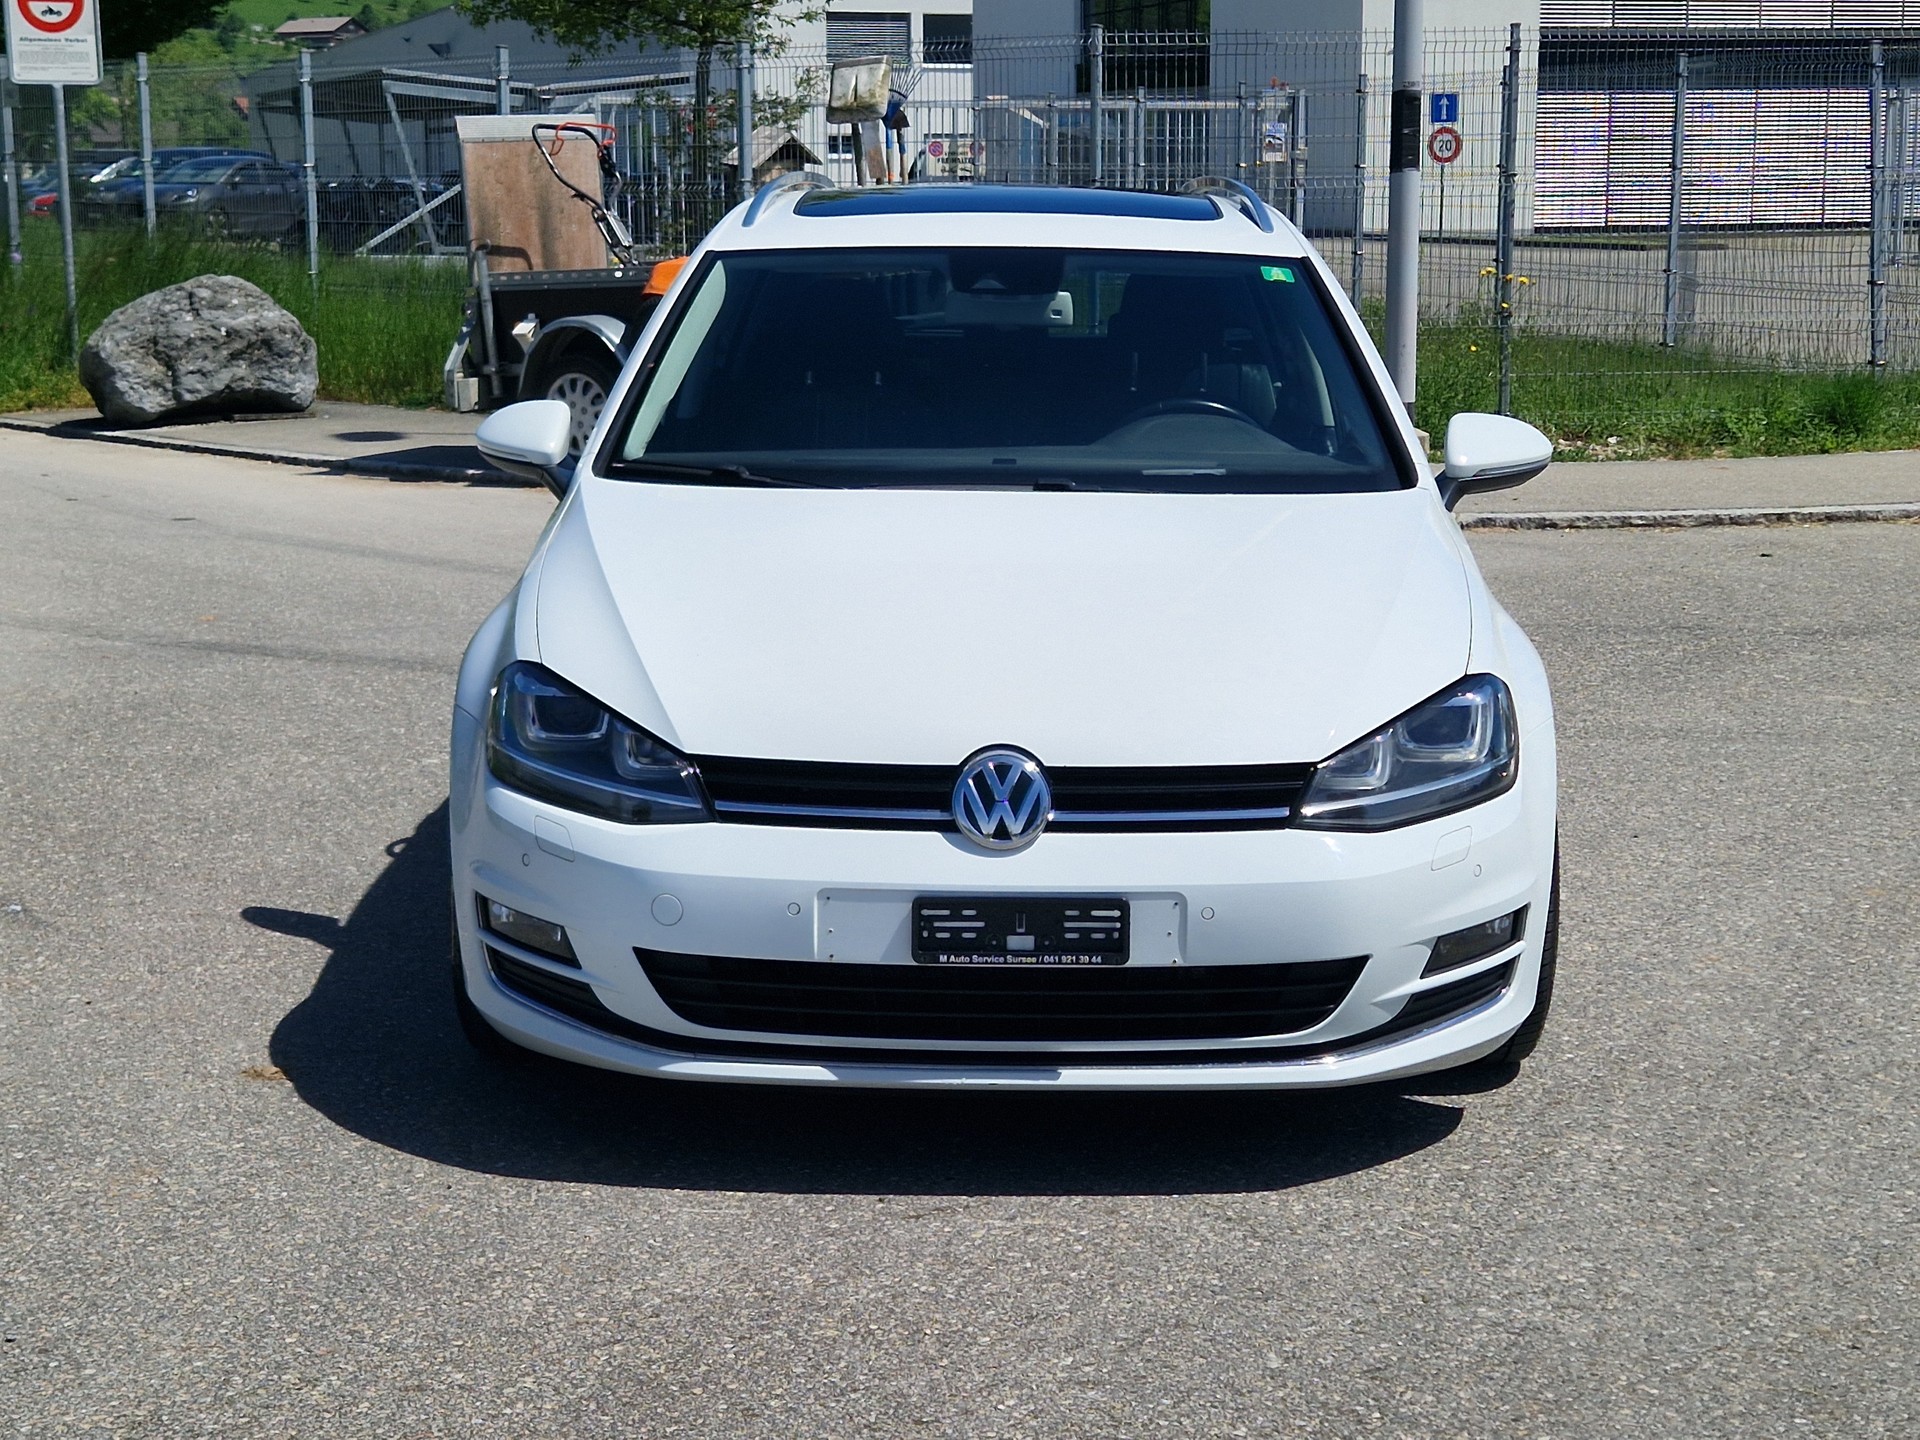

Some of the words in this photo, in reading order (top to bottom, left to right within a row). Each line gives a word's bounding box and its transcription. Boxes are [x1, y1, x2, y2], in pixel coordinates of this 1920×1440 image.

[1438, 139, 1452, 152] 20
[939, 954, 948, 963] M
[949, 954, 971, 963] Auto
[972, 954, 1005, 963] Service
[1006, 954, 1037, 964] Sursee
[1043, 955, 1059, 964] 041
[1061, 955, 1076, 964] 921
[1090, 955, 1102, 964] 44
